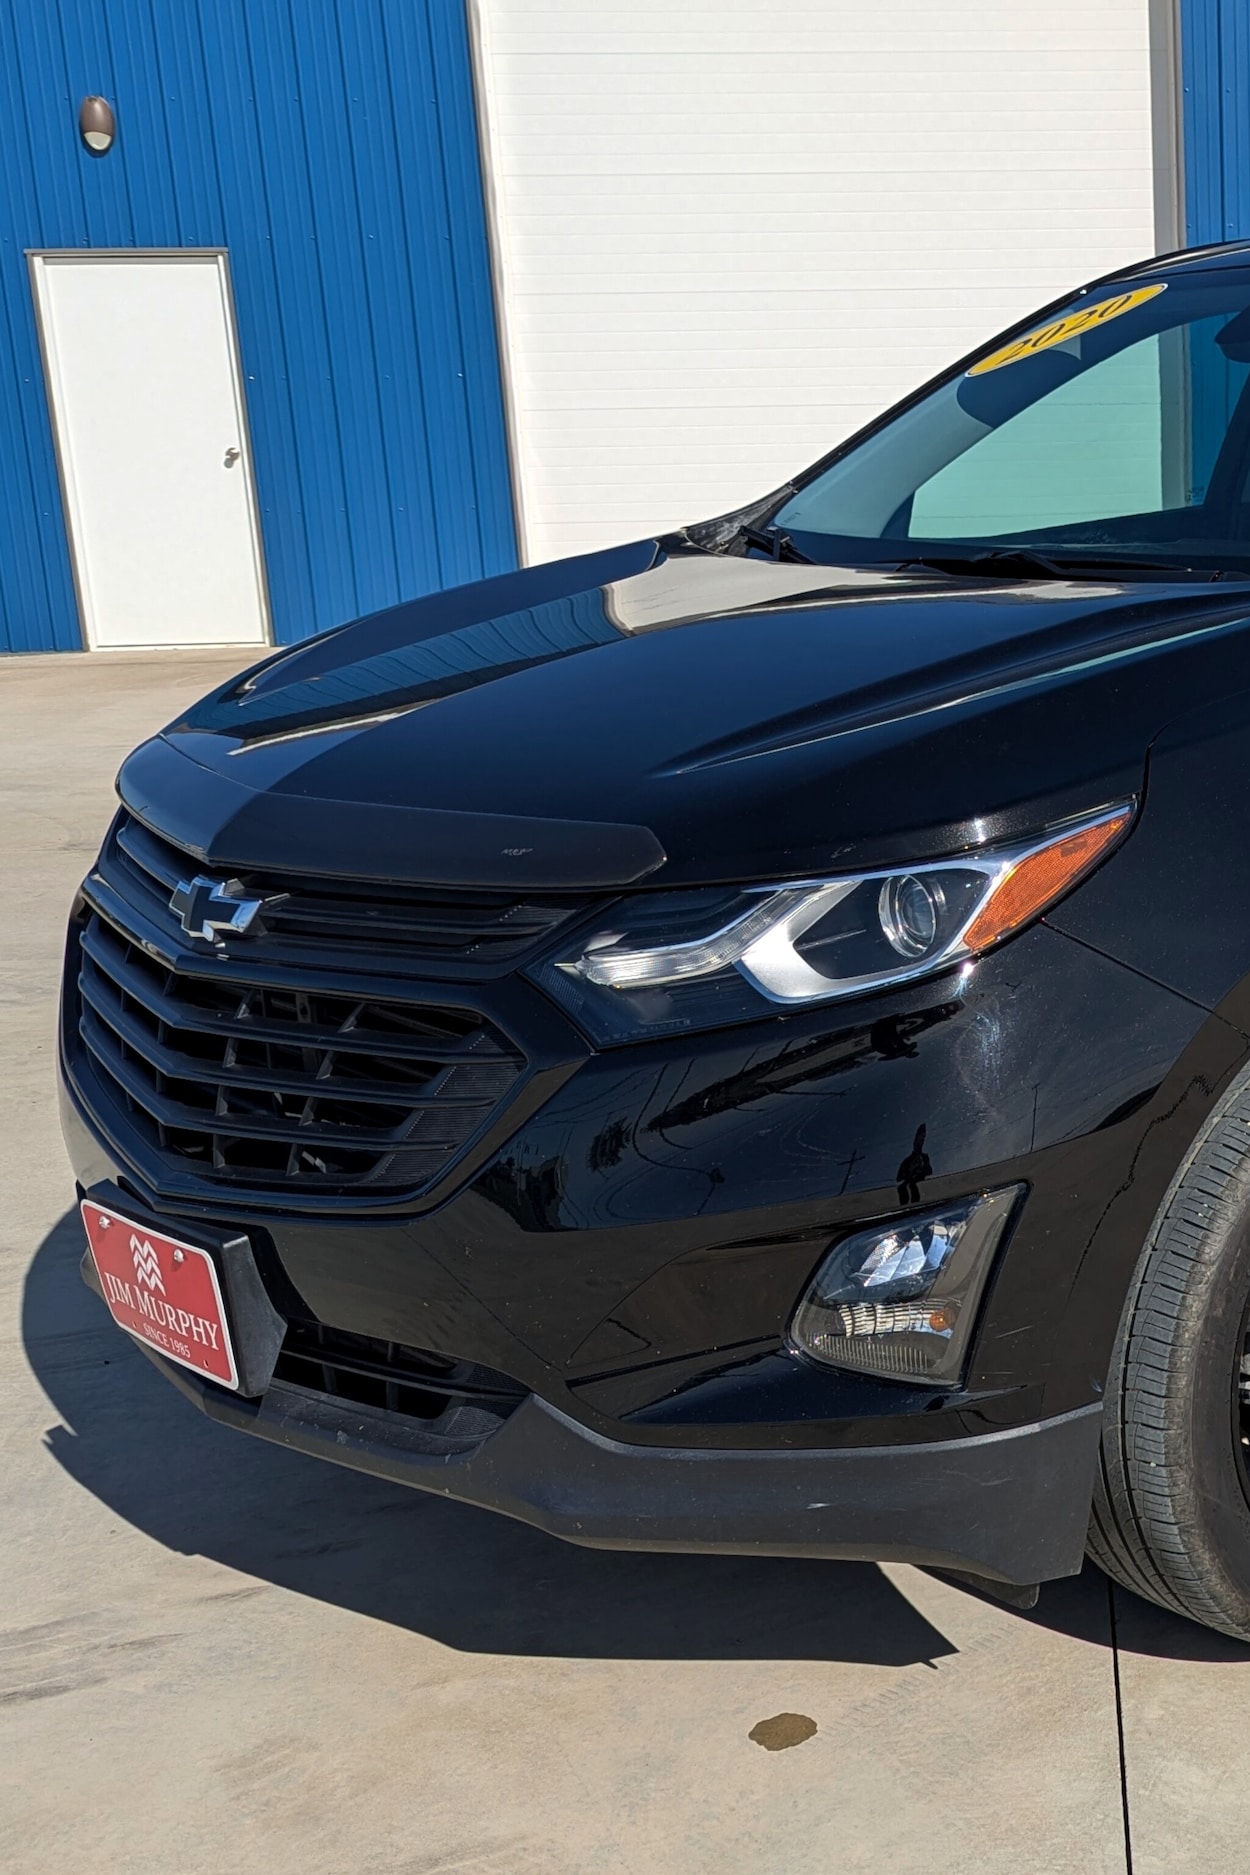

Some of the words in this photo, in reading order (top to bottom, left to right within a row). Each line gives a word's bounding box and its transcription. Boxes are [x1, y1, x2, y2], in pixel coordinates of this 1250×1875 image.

[995, 294, 1133, 366] 2020
[104, 1271, 137, 1311] JIM
[133, 1283, 220, 1351] MURPHY
[143, 1322, 170, 1348] SINCE
[169, 1337, 191, 1359] 1985
